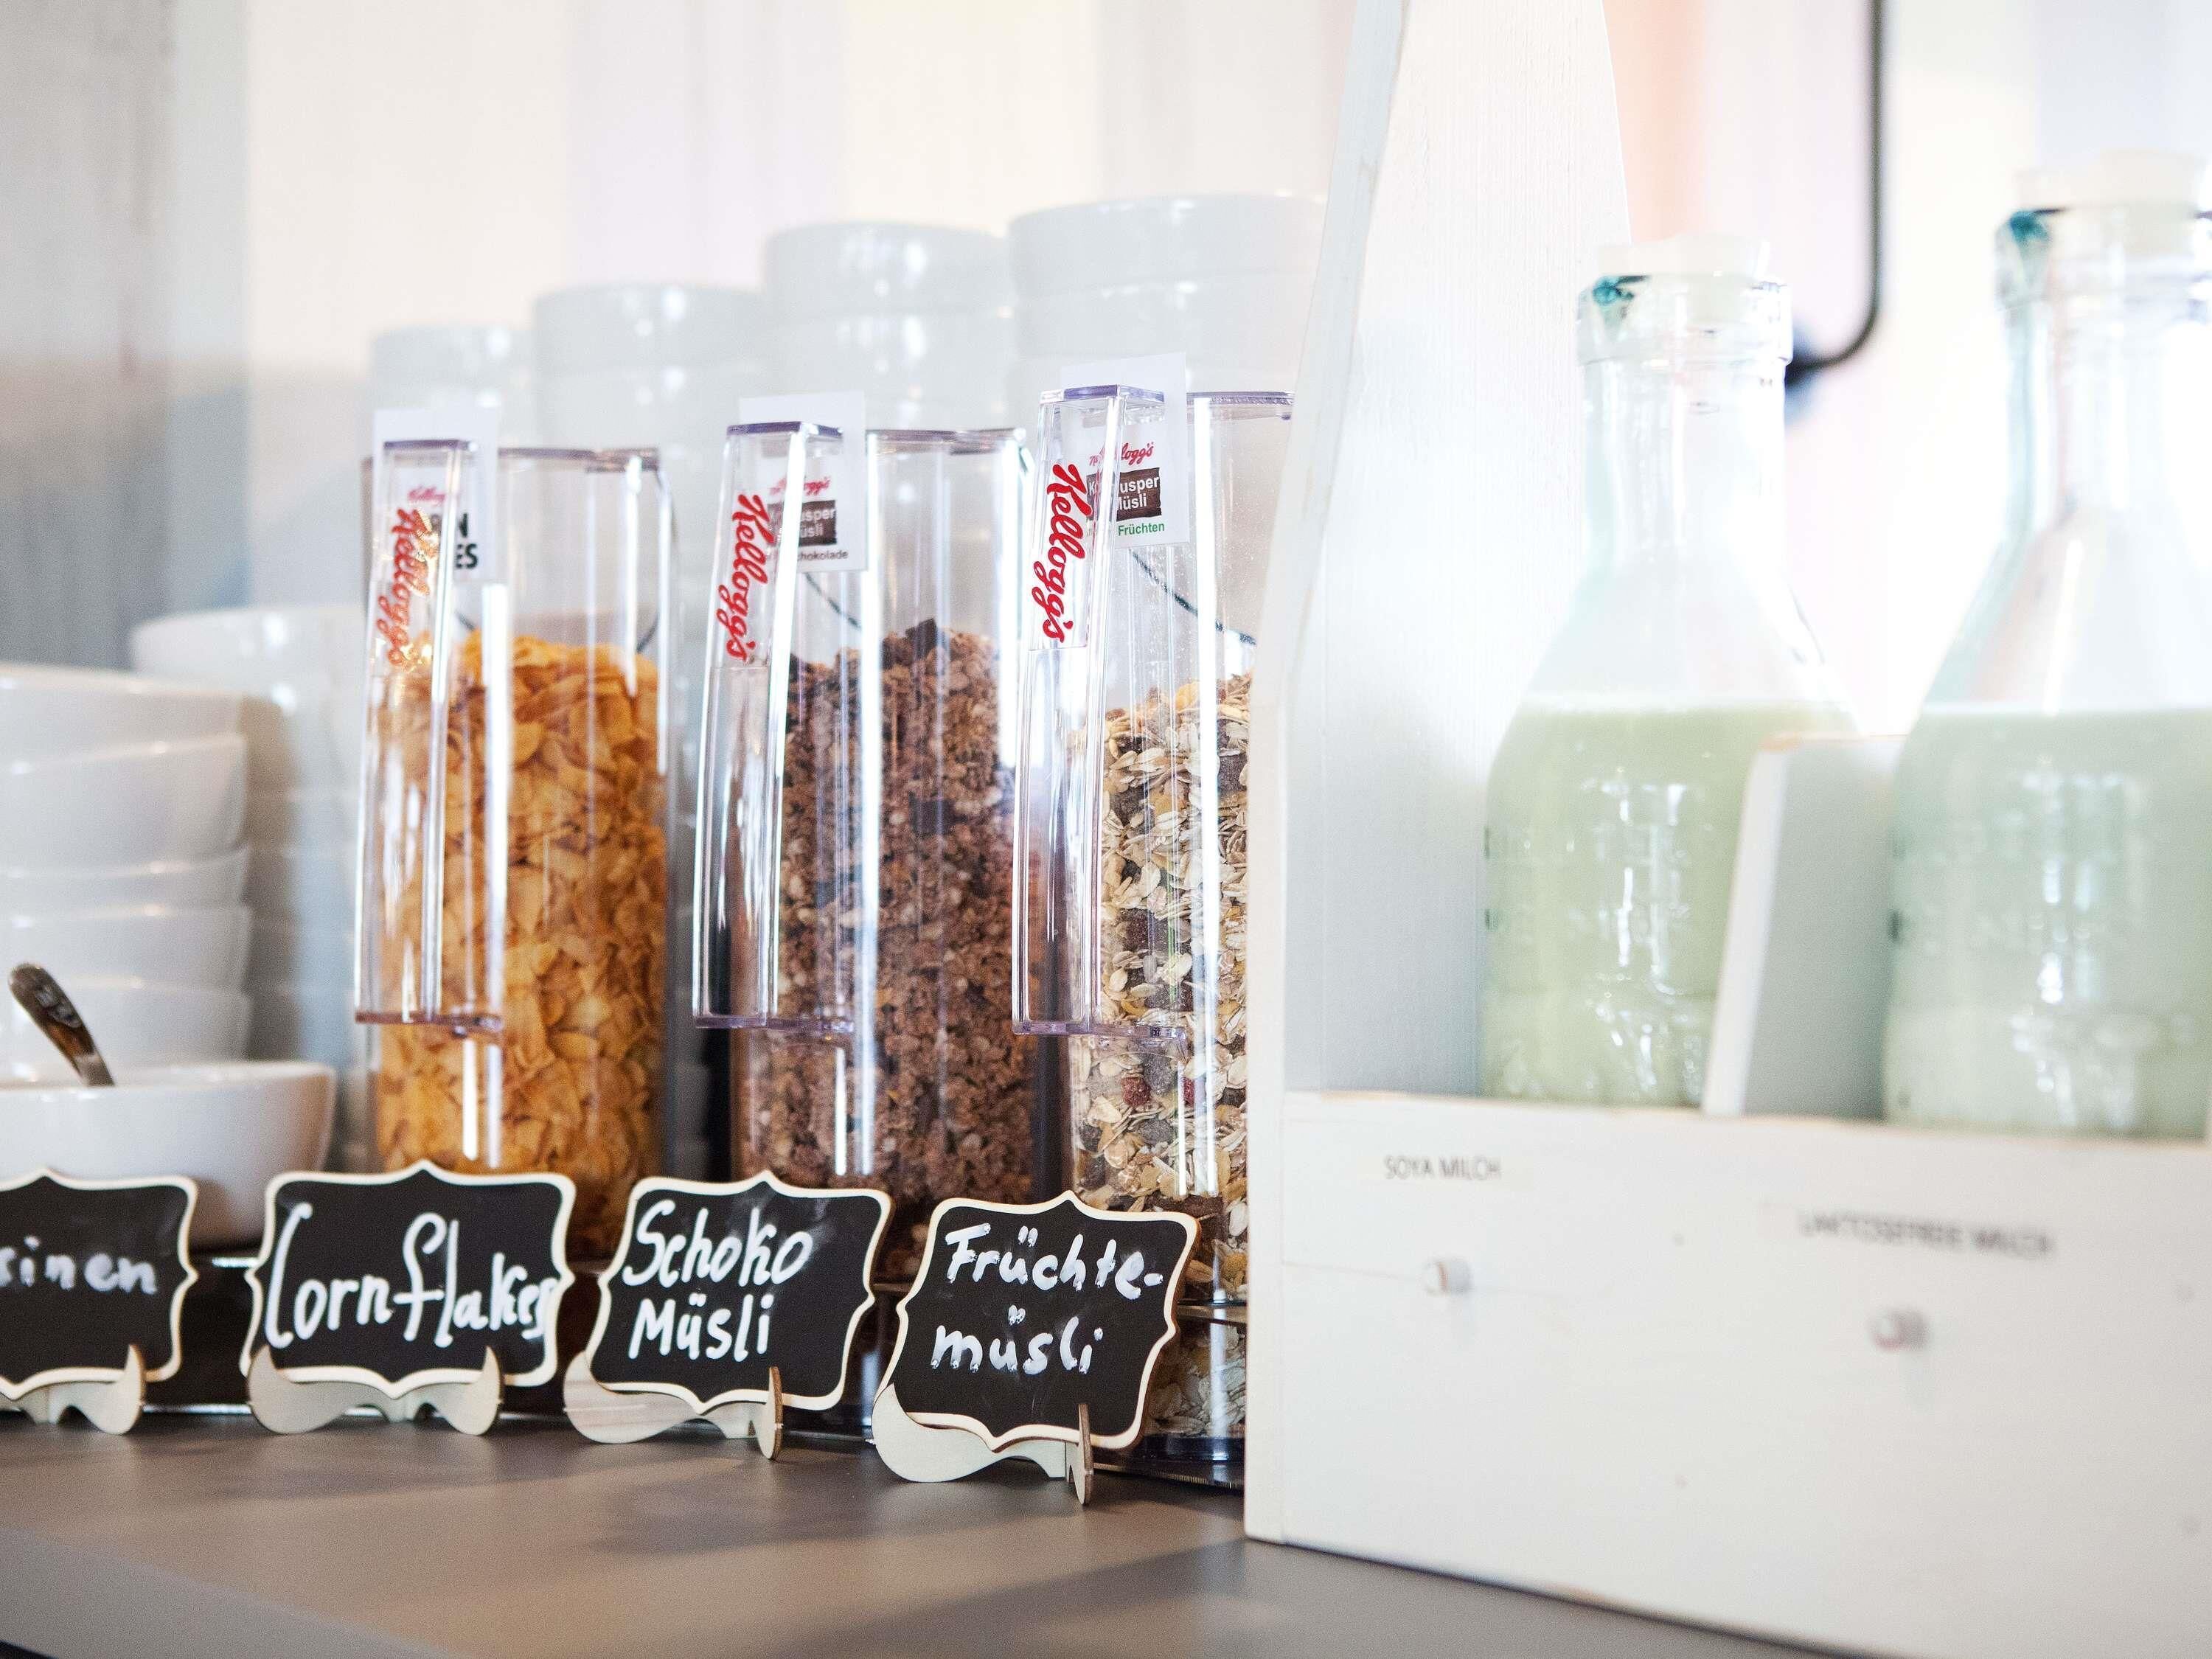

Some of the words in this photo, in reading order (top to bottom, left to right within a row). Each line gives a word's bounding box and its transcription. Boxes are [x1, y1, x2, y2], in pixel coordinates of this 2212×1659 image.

[1032, 464, 1093, 643] Kellogg's
[1118, 521, 1166, 537] Früchten
[377, 508, 429, 664] Kelloggs
[716, 493, 775, 662] Kellogg's
[1383, 1155, 1436, 1180] SOYA
[1439, 1155, 1502, 1181] MILCH
[623, 1200, 814, 1289] Schoko
[627, 1291, 776, 1363] Müsli
[931, 1304, 1106, 1376] müsli
